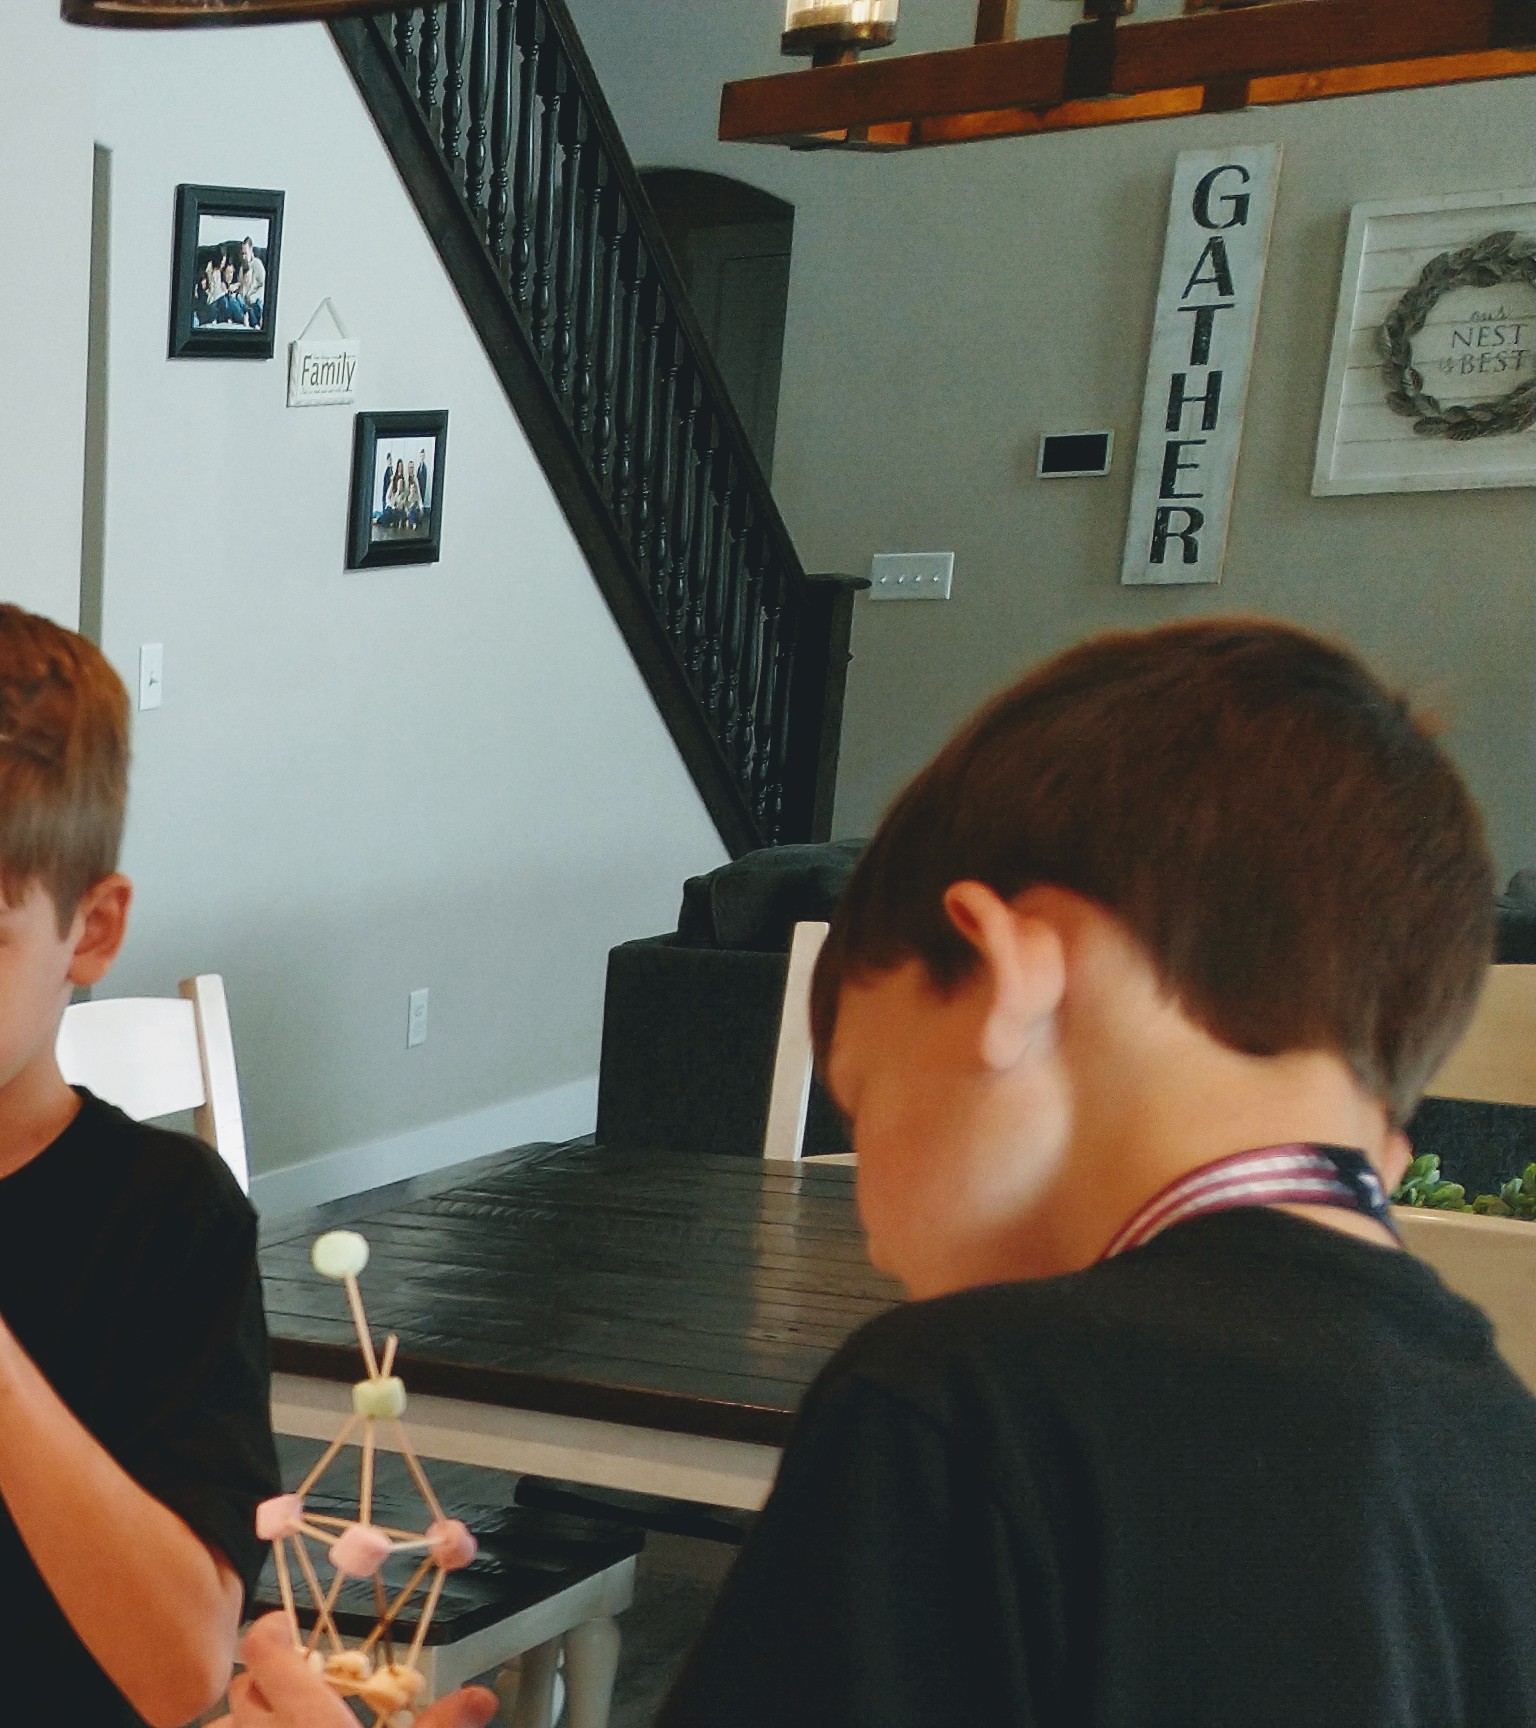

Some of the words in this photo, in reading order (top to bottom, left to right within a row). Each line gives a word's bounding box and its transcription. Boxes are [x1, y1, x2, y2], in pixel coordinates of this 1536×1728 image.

[1451, 324, 1528, 348] NEST
[301, 352, 356, 392] Family
[1149, 165, 1251, 564] GATHER
[1460, 349, 1530, 375] BEST
